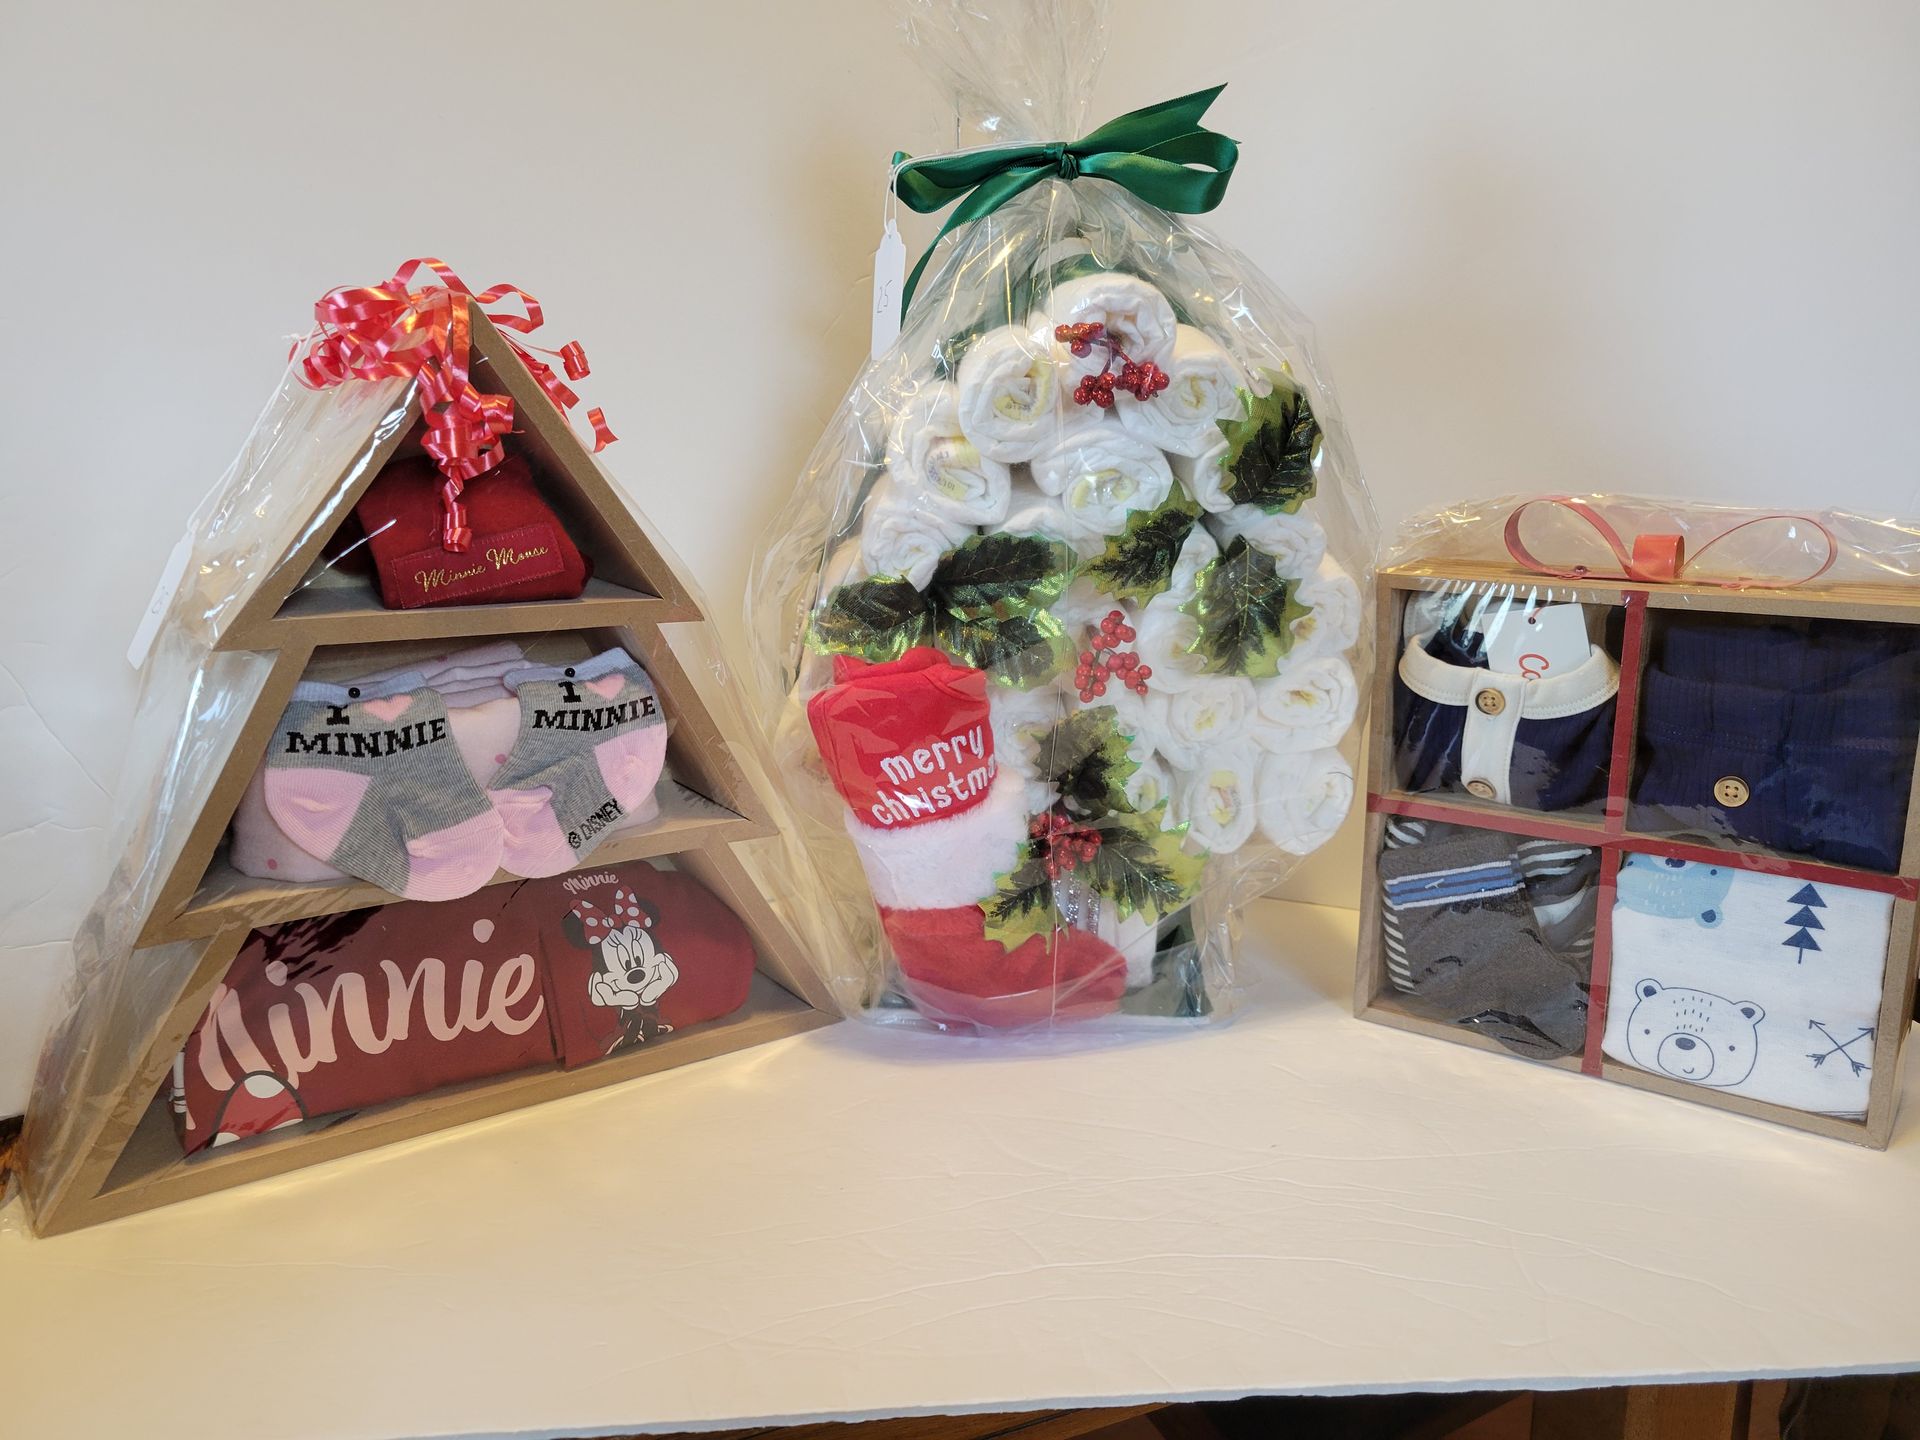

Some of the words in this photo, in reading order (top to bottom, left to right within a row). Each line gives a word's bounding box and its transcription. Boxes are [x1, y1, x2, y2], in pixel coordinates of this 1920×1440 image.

[414, 563, 486, 592] Minnie
[486, 546, 548, 570] Mouse
[559, 680, 581, 703] I
[326, 705, 350, 725] I
[532, 696, 657, 732] MINNIE
[285, 718, 447, 758] MINNIE
[880, 725, 985, 786] merry
[580, 798, 623, 841] DISNEY
[562, 871, 619, 895] Minnie
